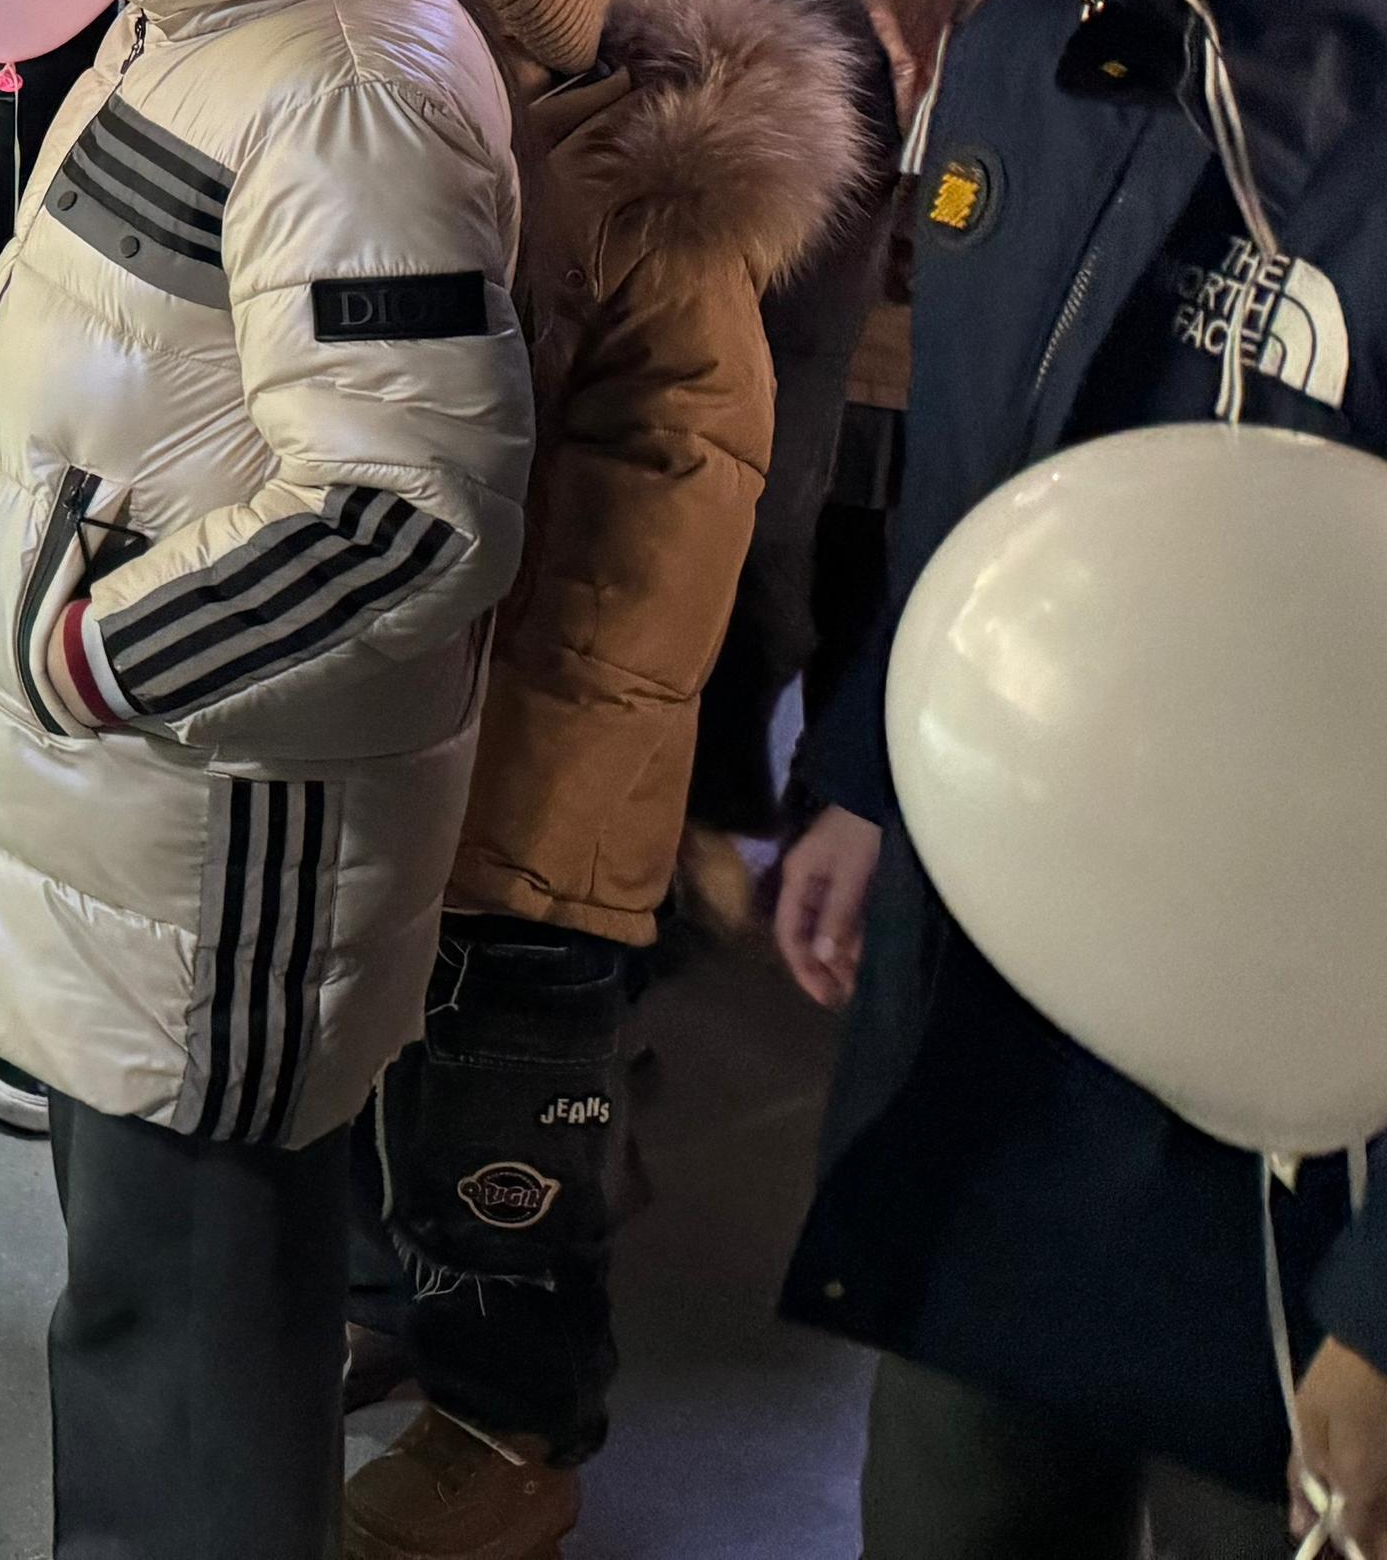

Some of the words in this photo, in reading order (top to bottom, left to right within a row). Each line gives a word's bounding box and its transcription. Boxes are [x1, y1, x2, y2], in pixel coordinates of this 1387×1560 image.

[1222, 236, 1291, 290] THE
[1177, 265, 1276, 334] ORTH
[1173, 304, 1263, 367] FACE
[539, 1097, 610, 1124] JEANS
